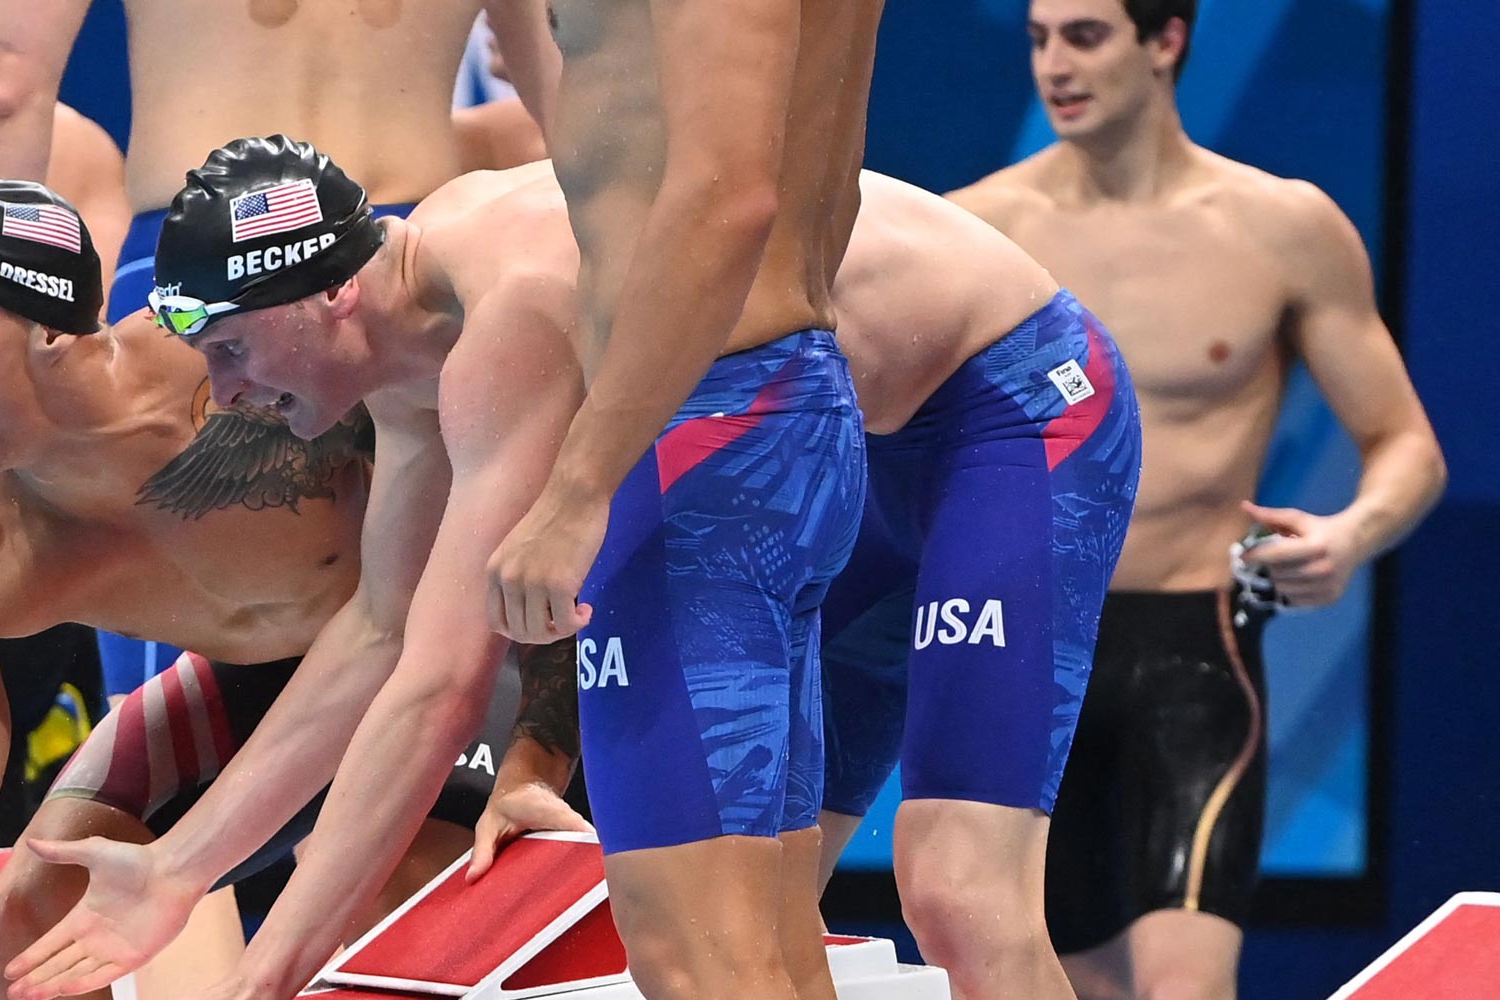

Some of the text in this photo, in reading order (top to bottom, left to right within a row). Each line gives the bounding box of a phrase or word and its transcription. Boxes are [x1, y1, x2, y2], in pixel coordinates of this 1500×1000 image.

[0, 262, 75, 302] DRESSEL
[914, 598, 1006, 650] USA
[576, 636, 629, 690] SA
